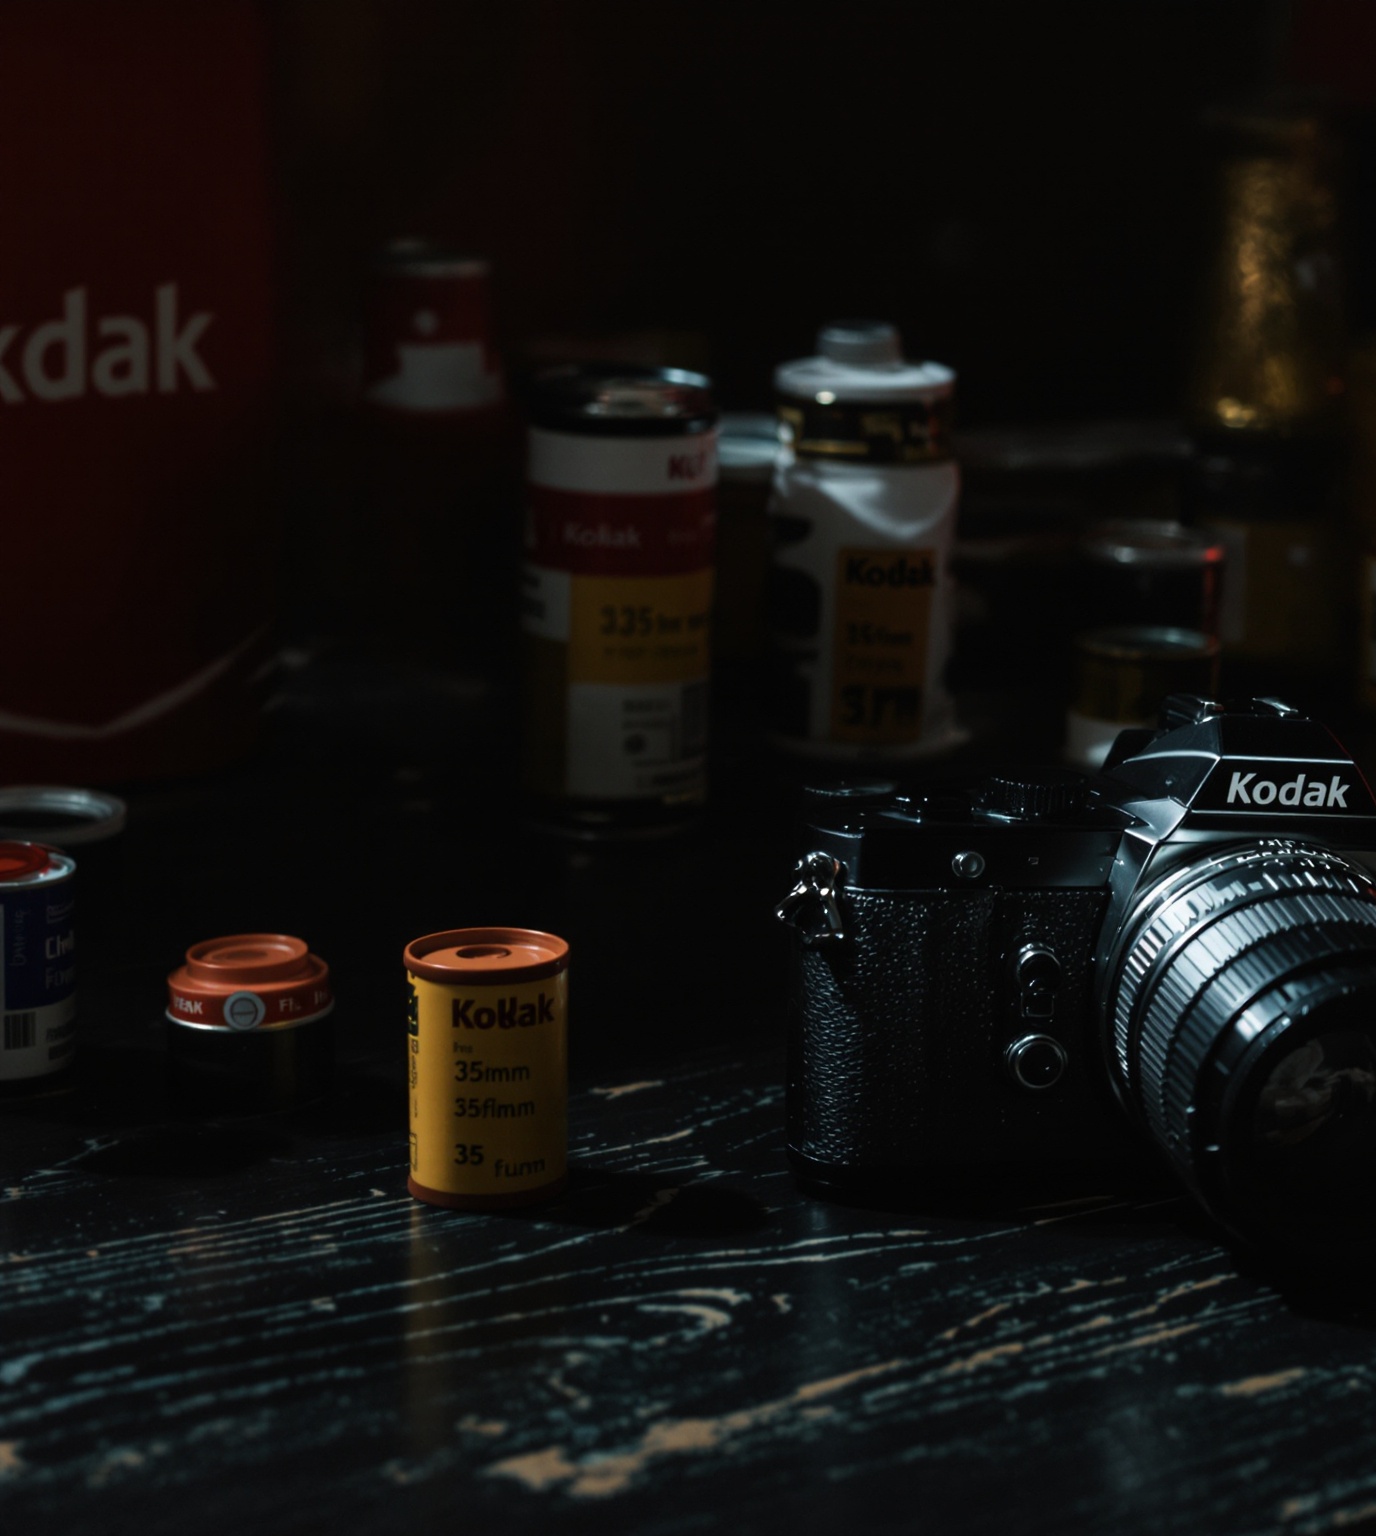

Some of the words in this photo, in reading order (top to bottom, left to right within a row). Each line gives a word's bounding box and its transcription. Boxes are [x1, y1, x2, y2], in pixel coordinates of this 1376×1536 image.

[1226, 771, 1351, 809] Kodak
[455, 1060, 530, 1083] 35mm
[454, 1144, 484, 1166] 35
